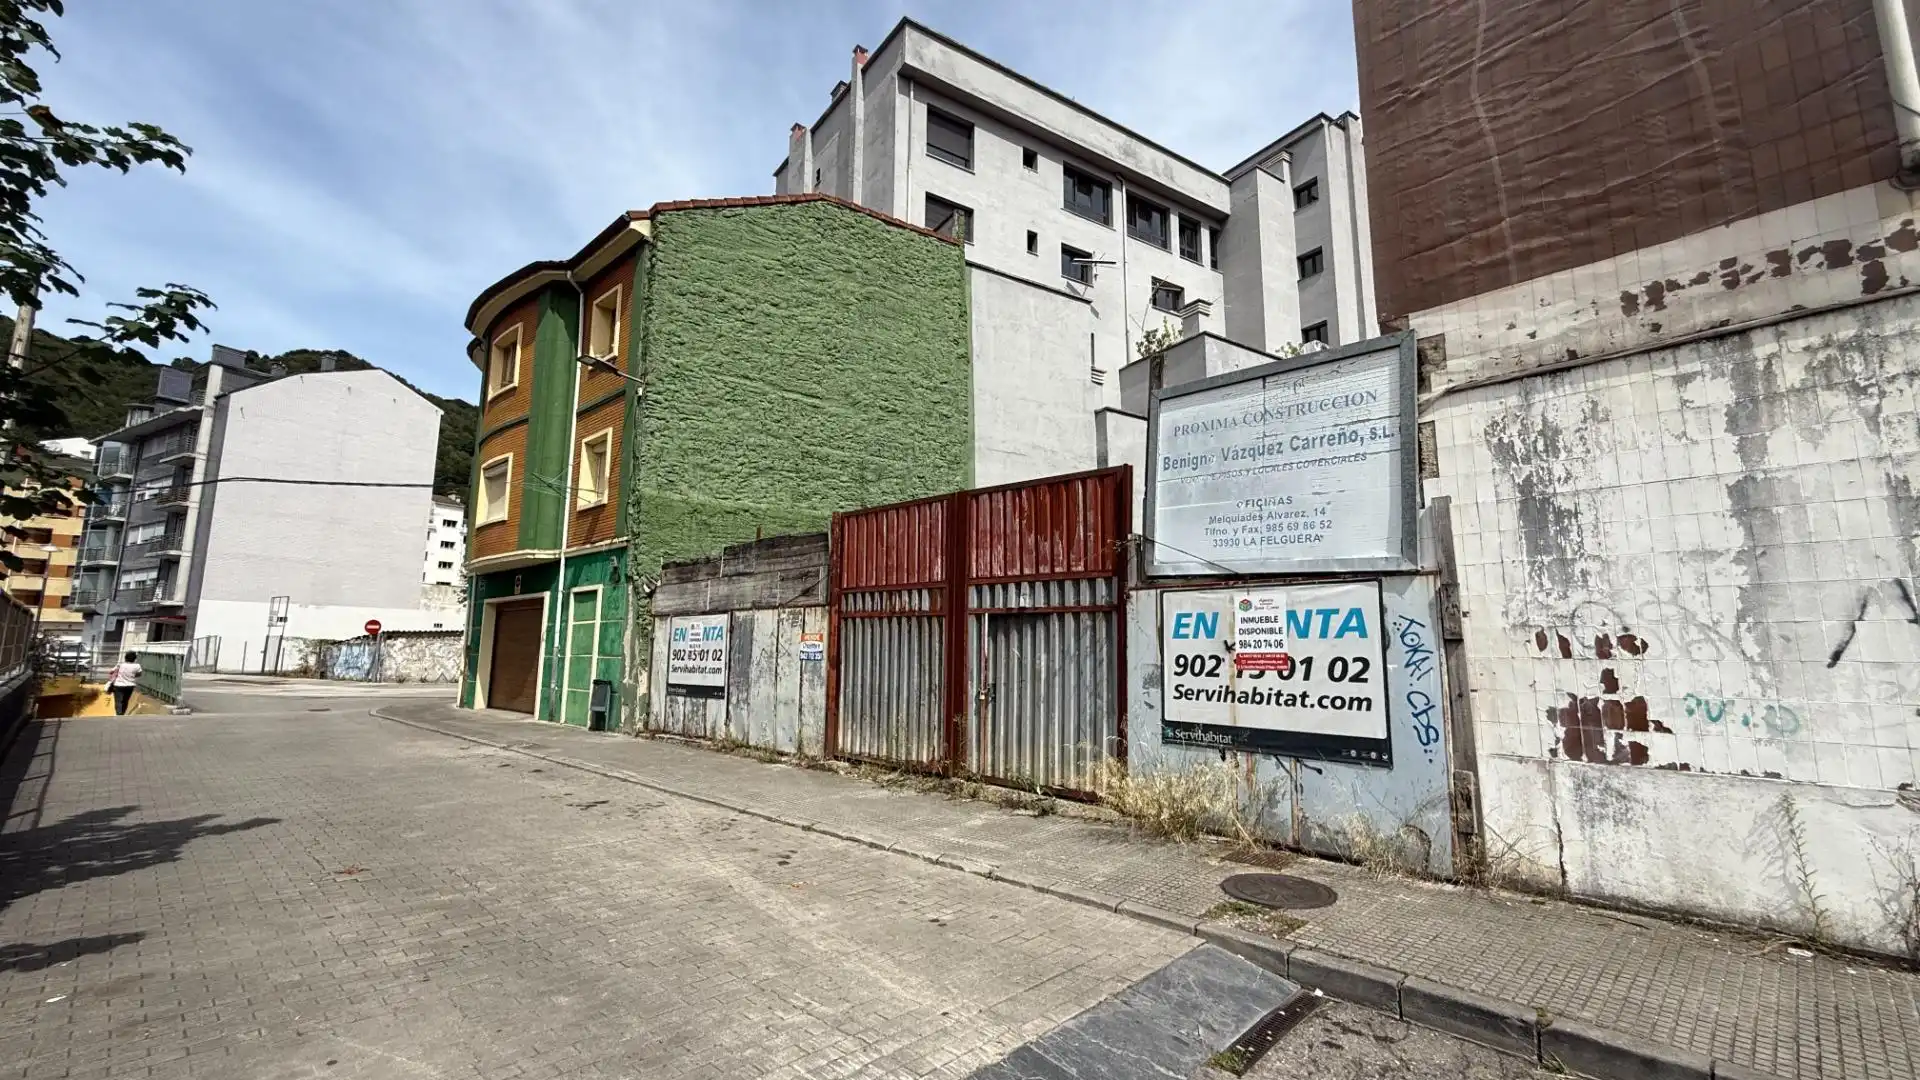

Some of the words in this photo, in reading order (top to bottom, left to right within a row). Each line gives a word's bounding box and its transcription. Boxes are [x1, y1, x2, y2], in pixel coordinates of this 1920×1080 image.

[1173, 416, 1238, 438] PROXIMA
[1242, 389, 1378, 426] CONSTRUCCION
[1221, 441, 1284, 462] Vázquez
[1289, 427, 1365, 452] Carreño,
[1369, 425, 1395, 441] S.L.
[1208, 512, 1263, 526] Melquiades
[1313, 506, 1326, 517] 14
[1233, 528, 1239, 537] y
[1265, 522, 1284, 533] 985
[1286, 521, 1299, 532] 69
[1303, 520, 1316, 531] 86
[1319, 519, 1333, 530] 52
[1212, 537, 1240, 548] 33930
[1243, 537, 1257, 547] LA
[1260, 533, 1322, 547] FELGUERA
[1172, 611, 1219, 640] EN
[1286, 607, 1369, 640] NTA
[1240, 615, 1279, 625] INMUEBLE
[673, 627, 688, 642] EN
[702, 626, 724, 642] NTA
[1238, 626, 1284, 636] DISPONIBLE
[1238, 639, 1252, 650] 984
[1252, 639, 1263, 649] 20
[1273, 639, 1285, 649] 06
[672, 648, 687, 662] 902
[711, 648, 723, 662] 02
[671, 663, 723, 676] Servihabitat.com
[1173, 653, 1222, 678] 902
[1276, 655, 1314, 682] 01
[1327, 655, 1371, 683] 02
[1172, 683, 1373, 712] Servihabitat.com
[1174, 728, 1233, 744] Servihabitat
